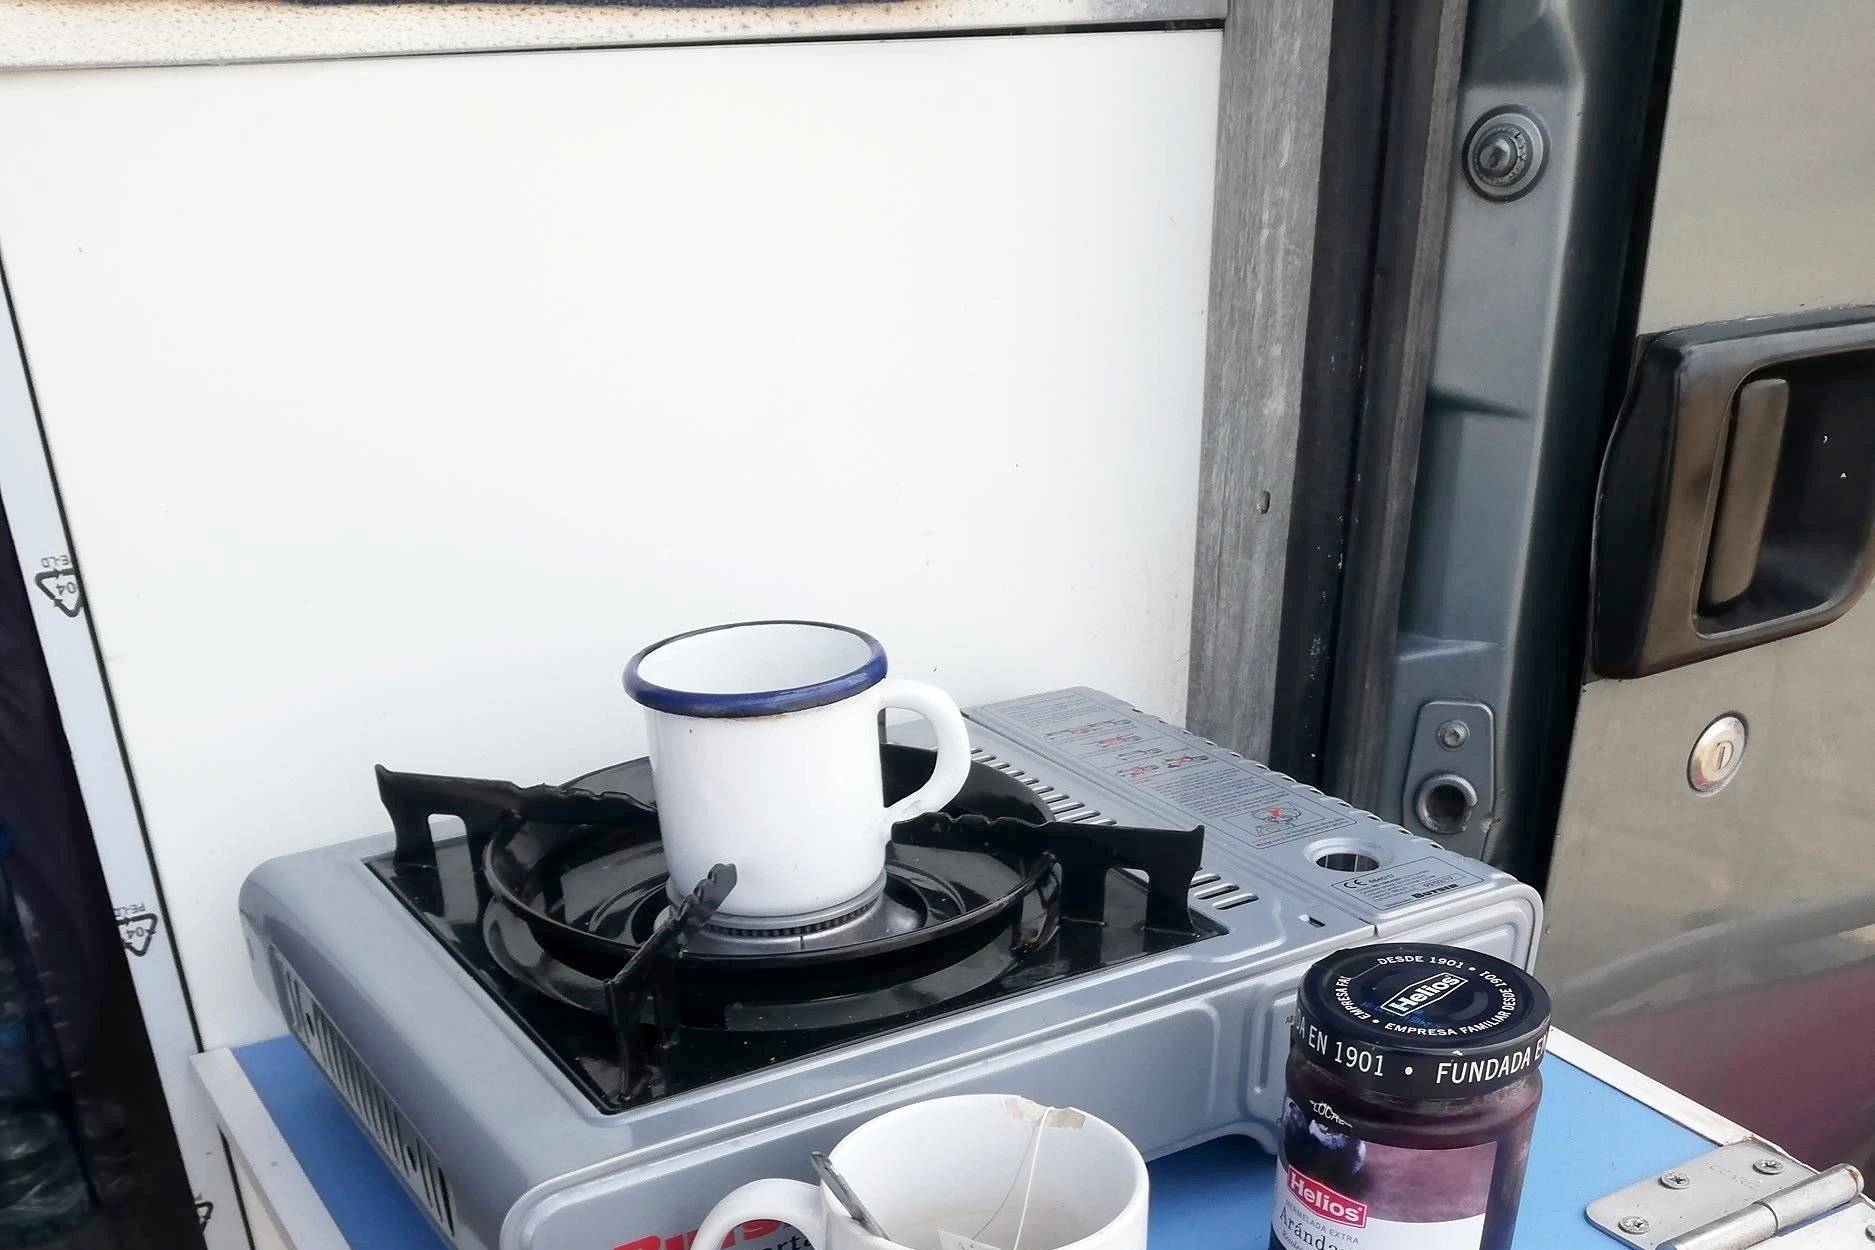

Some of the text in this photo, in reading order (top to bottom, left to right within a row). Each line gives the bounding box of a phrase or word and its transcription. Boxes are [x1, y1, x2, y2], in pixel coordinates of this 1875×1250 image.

[1376, 955, 1464, 970] DESDE 1901
[1335, 987, 1372, 1021] EMPRESA
[1383, 970, 1518, 1037] EMPRESA FAMILIAR DESDE 1901
[1388, 974, 1461, 1013] Helios
[1308, 1024, 1329, 1055] EN
[1333, 1041, 1385, 1078] 1901
[1436, 1046, 1532, 1085] FUNDADA
[1290, 1172, 1360, 1222] Helios
[1329, 1228, 1361, 1245] EXTRA
